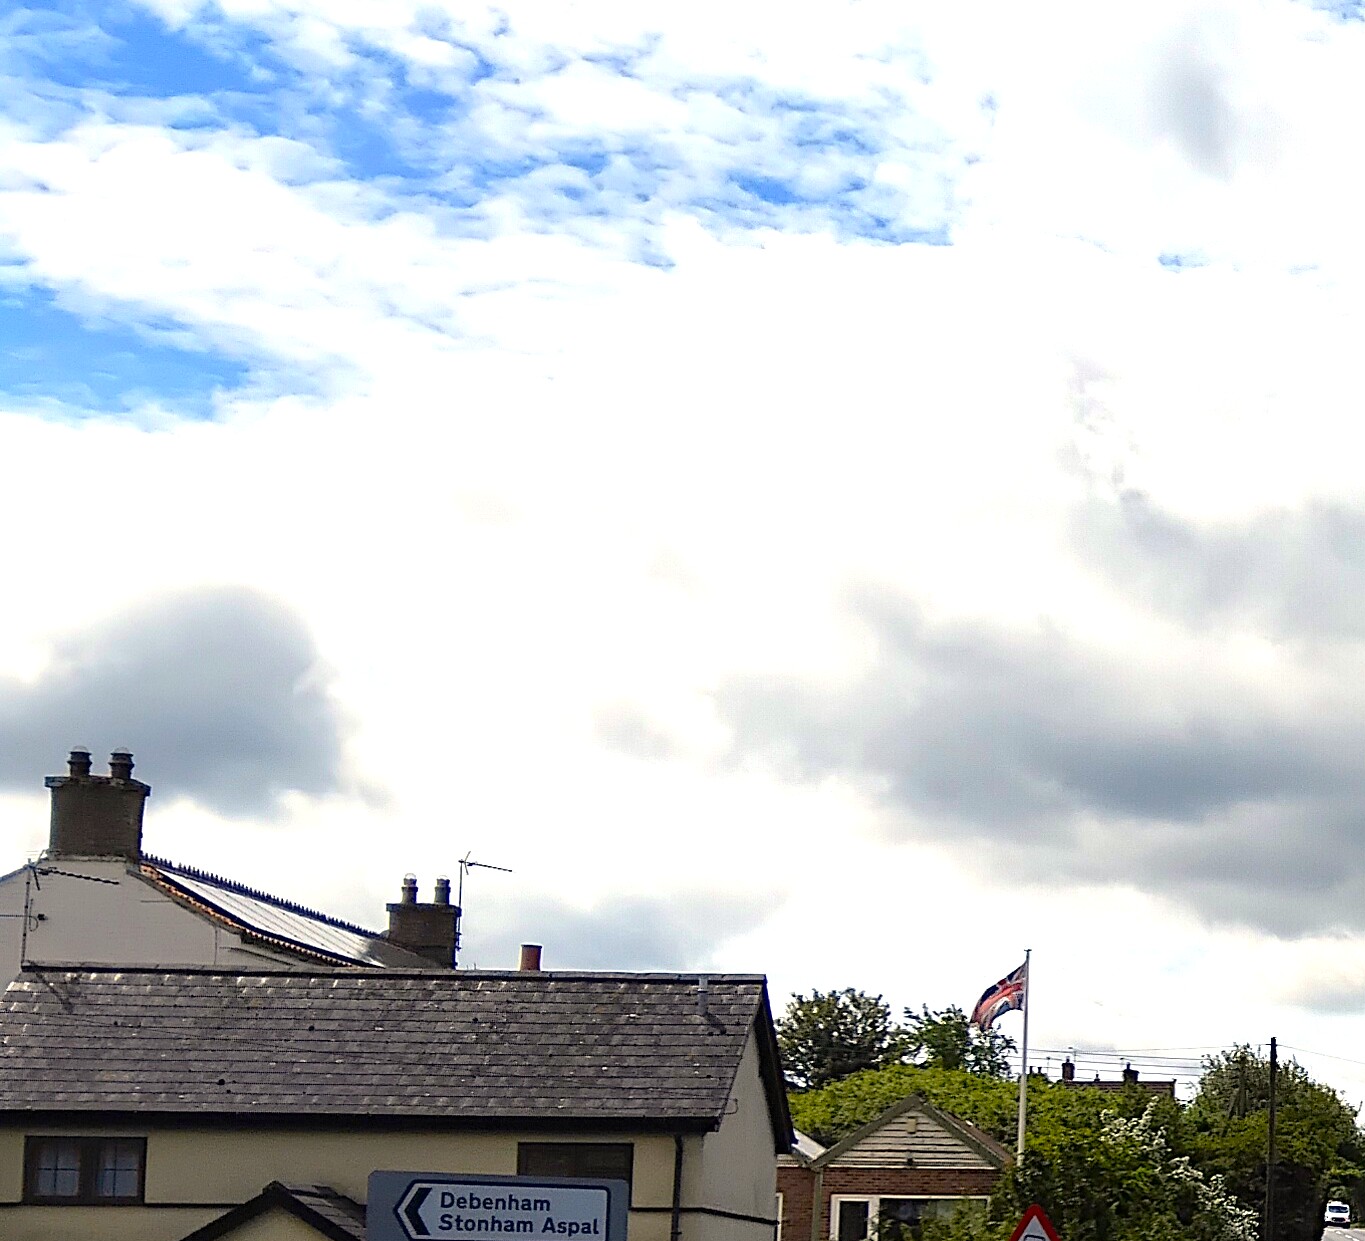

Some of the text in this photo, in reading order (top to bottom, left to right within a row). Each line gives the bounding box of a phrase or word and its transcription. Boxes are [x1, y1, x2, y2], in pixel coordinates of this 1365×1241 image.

[440, 1191, 551, 1212] Debenham
[438, 1213, 600, 1237] Stonham Aspal
